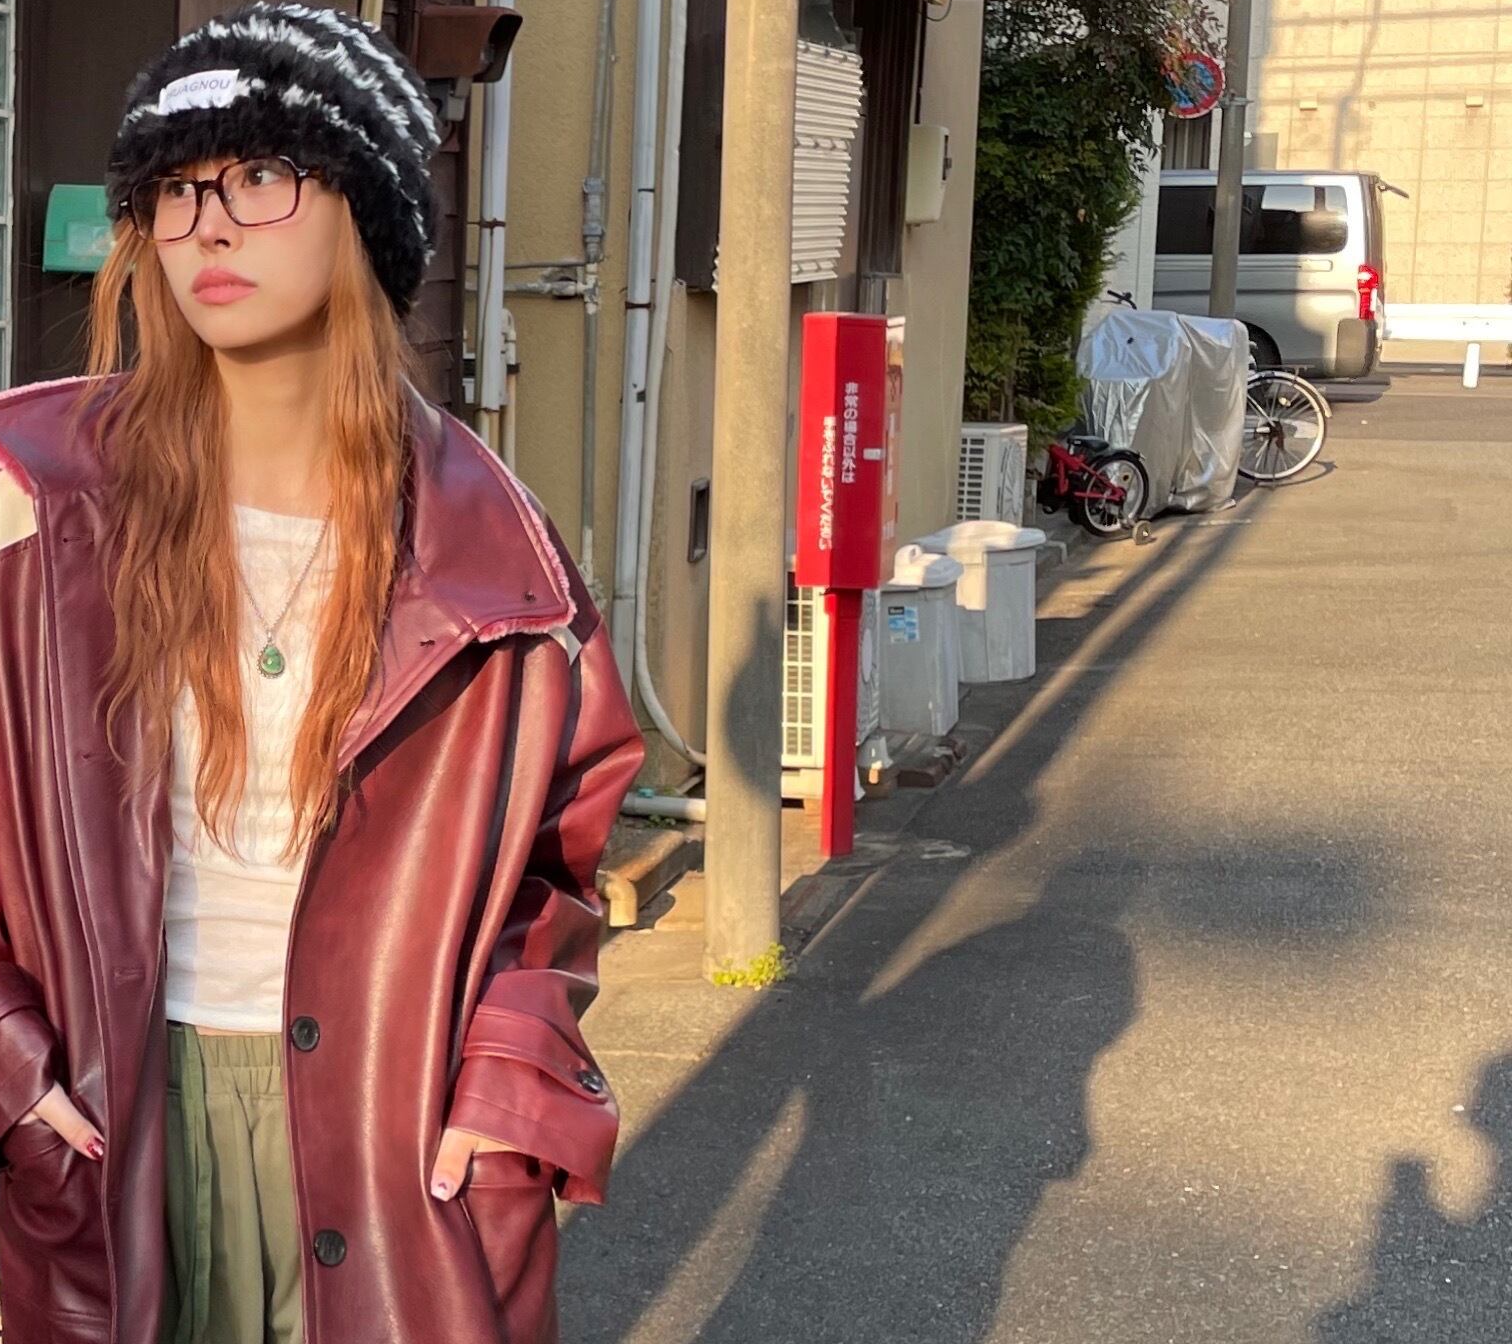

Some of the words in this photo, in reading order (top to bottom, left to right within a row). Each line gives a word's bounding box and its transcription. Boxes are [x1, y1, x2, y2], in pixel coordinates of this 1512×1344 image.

[841, 381, 859, 484] 非常の場合以外は
